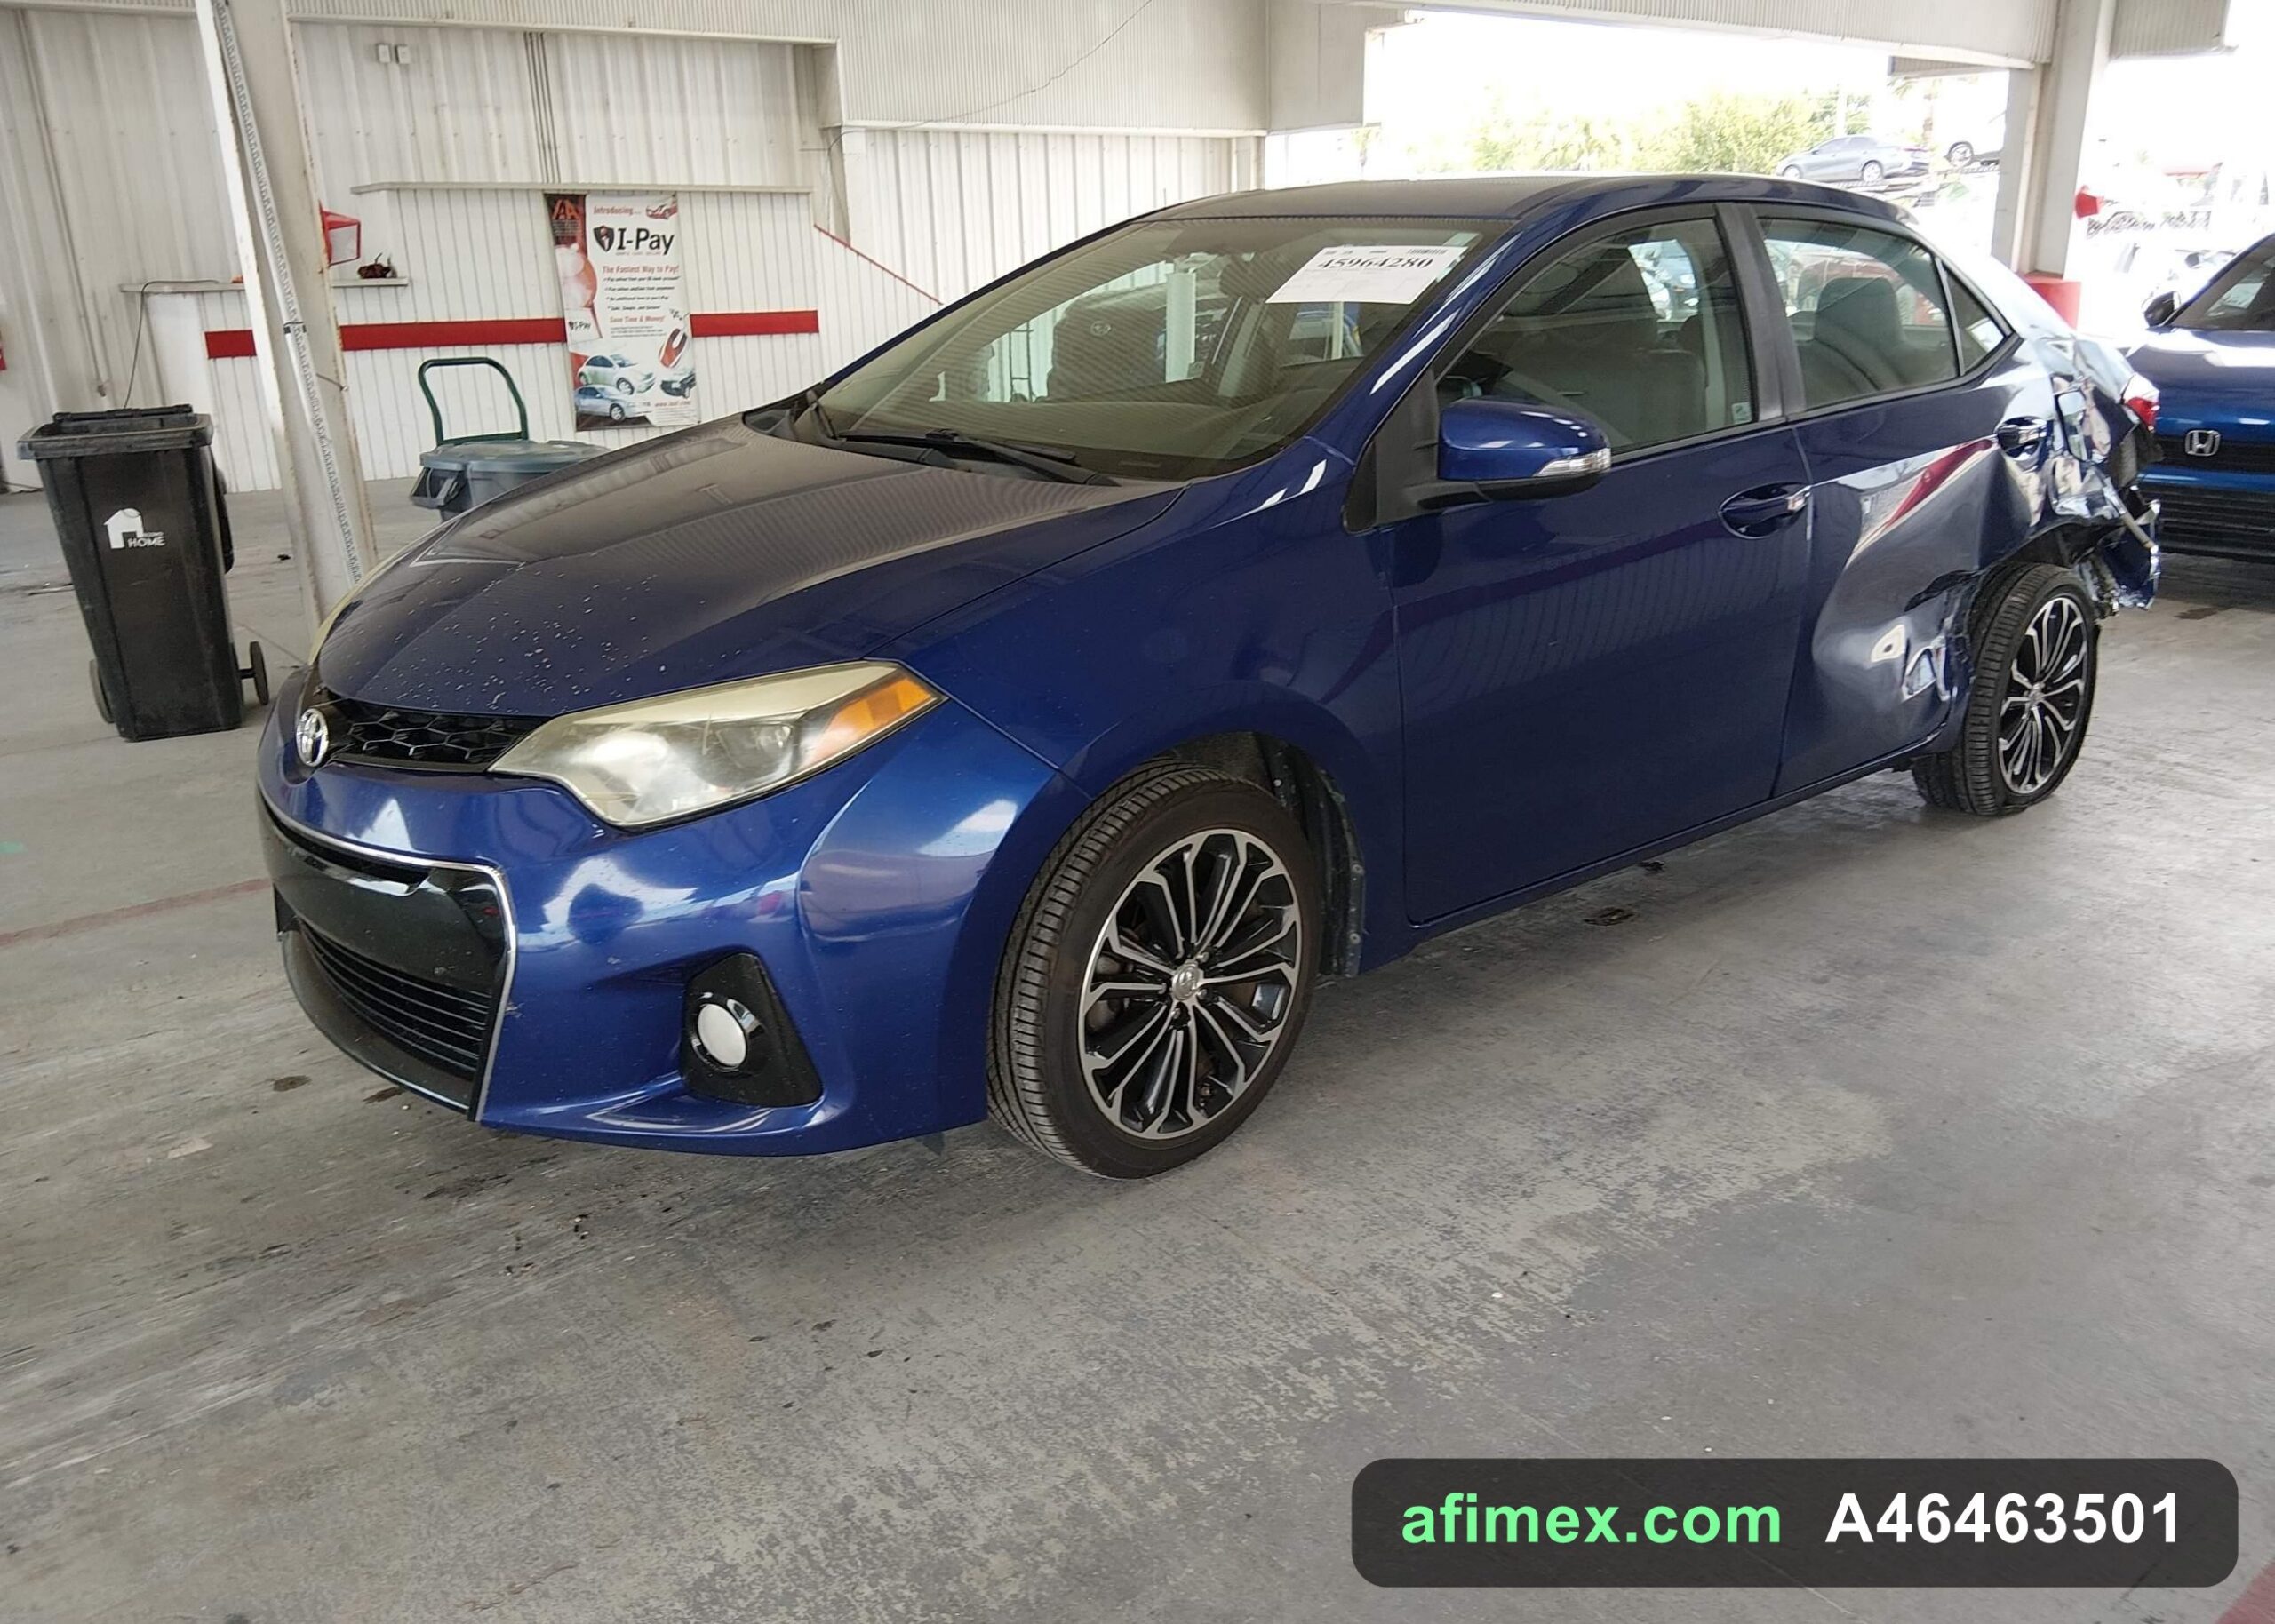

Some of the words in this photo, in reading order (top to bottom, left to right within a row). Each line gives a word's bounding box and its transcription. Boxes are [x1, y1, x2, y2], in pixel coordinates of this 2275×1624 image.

[617, 227, 675, 255] I-Pay
[616, 265, 640, 274] Fastest
[642, 266, 655, 275] Way
[127, 536, 166, 548] HOME
